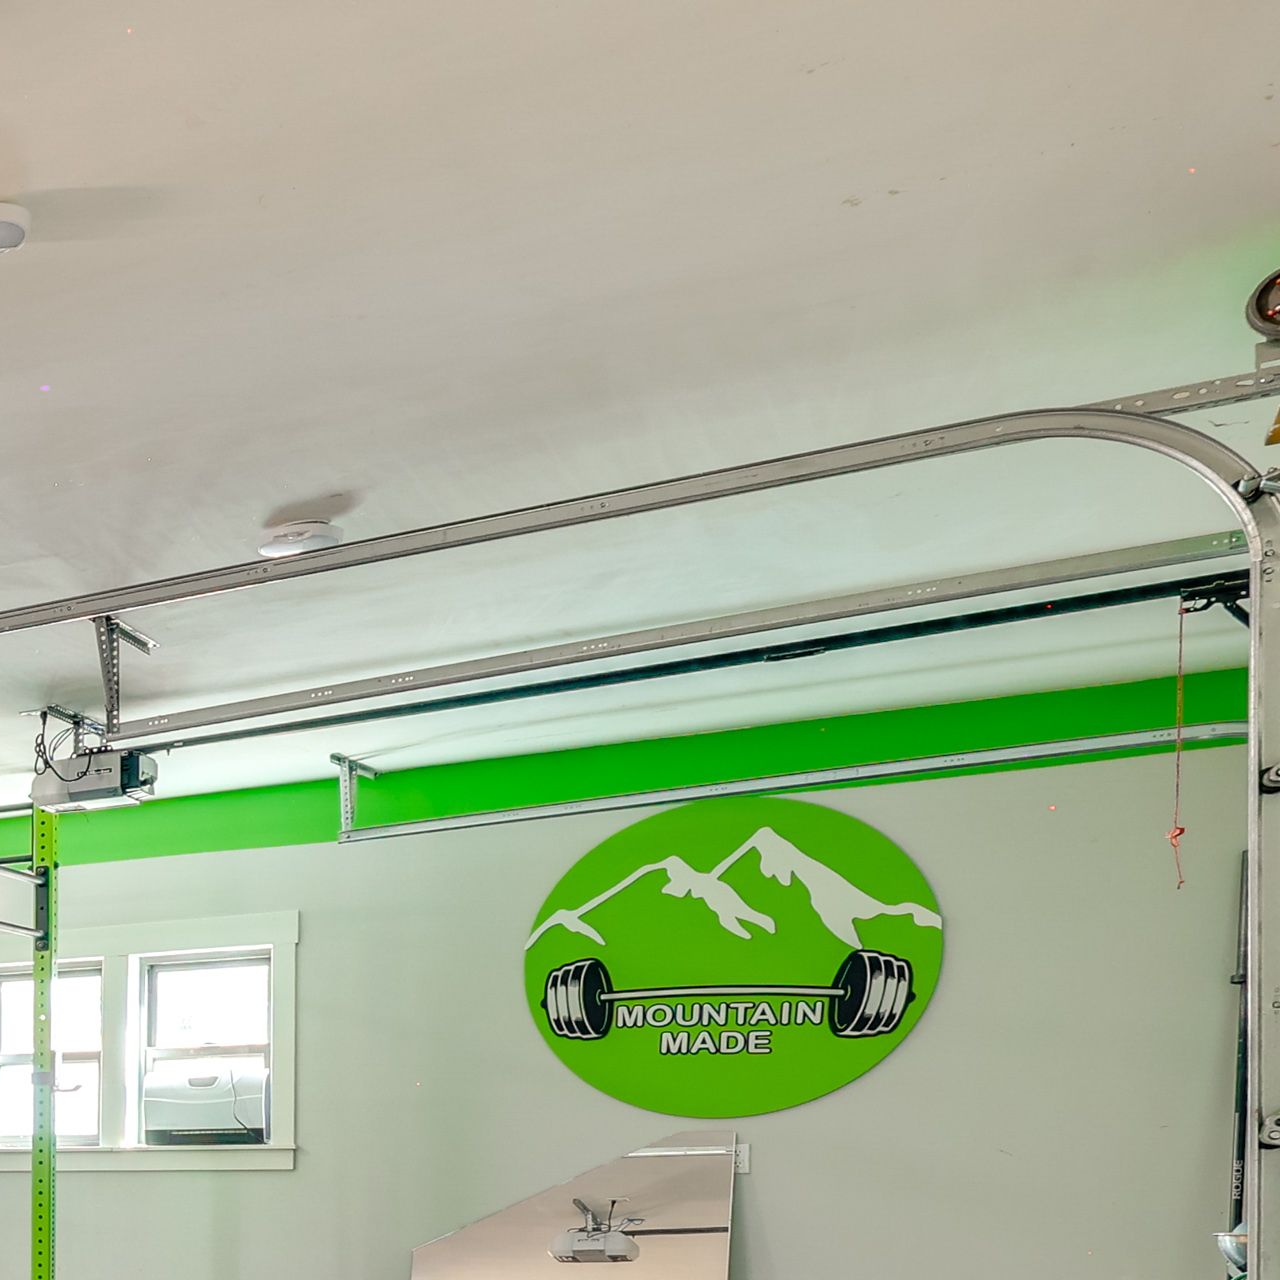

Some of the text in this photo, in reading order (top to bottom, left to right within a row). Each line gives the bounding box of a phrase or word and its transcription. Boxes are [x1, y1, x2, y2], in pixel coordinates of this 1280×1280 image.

[615, 1001, 824, 1028] MOUNTAIN
[659, 1030, 772, 1055] MADE
[1232, 1160, 1243, 1200] ROGUE
